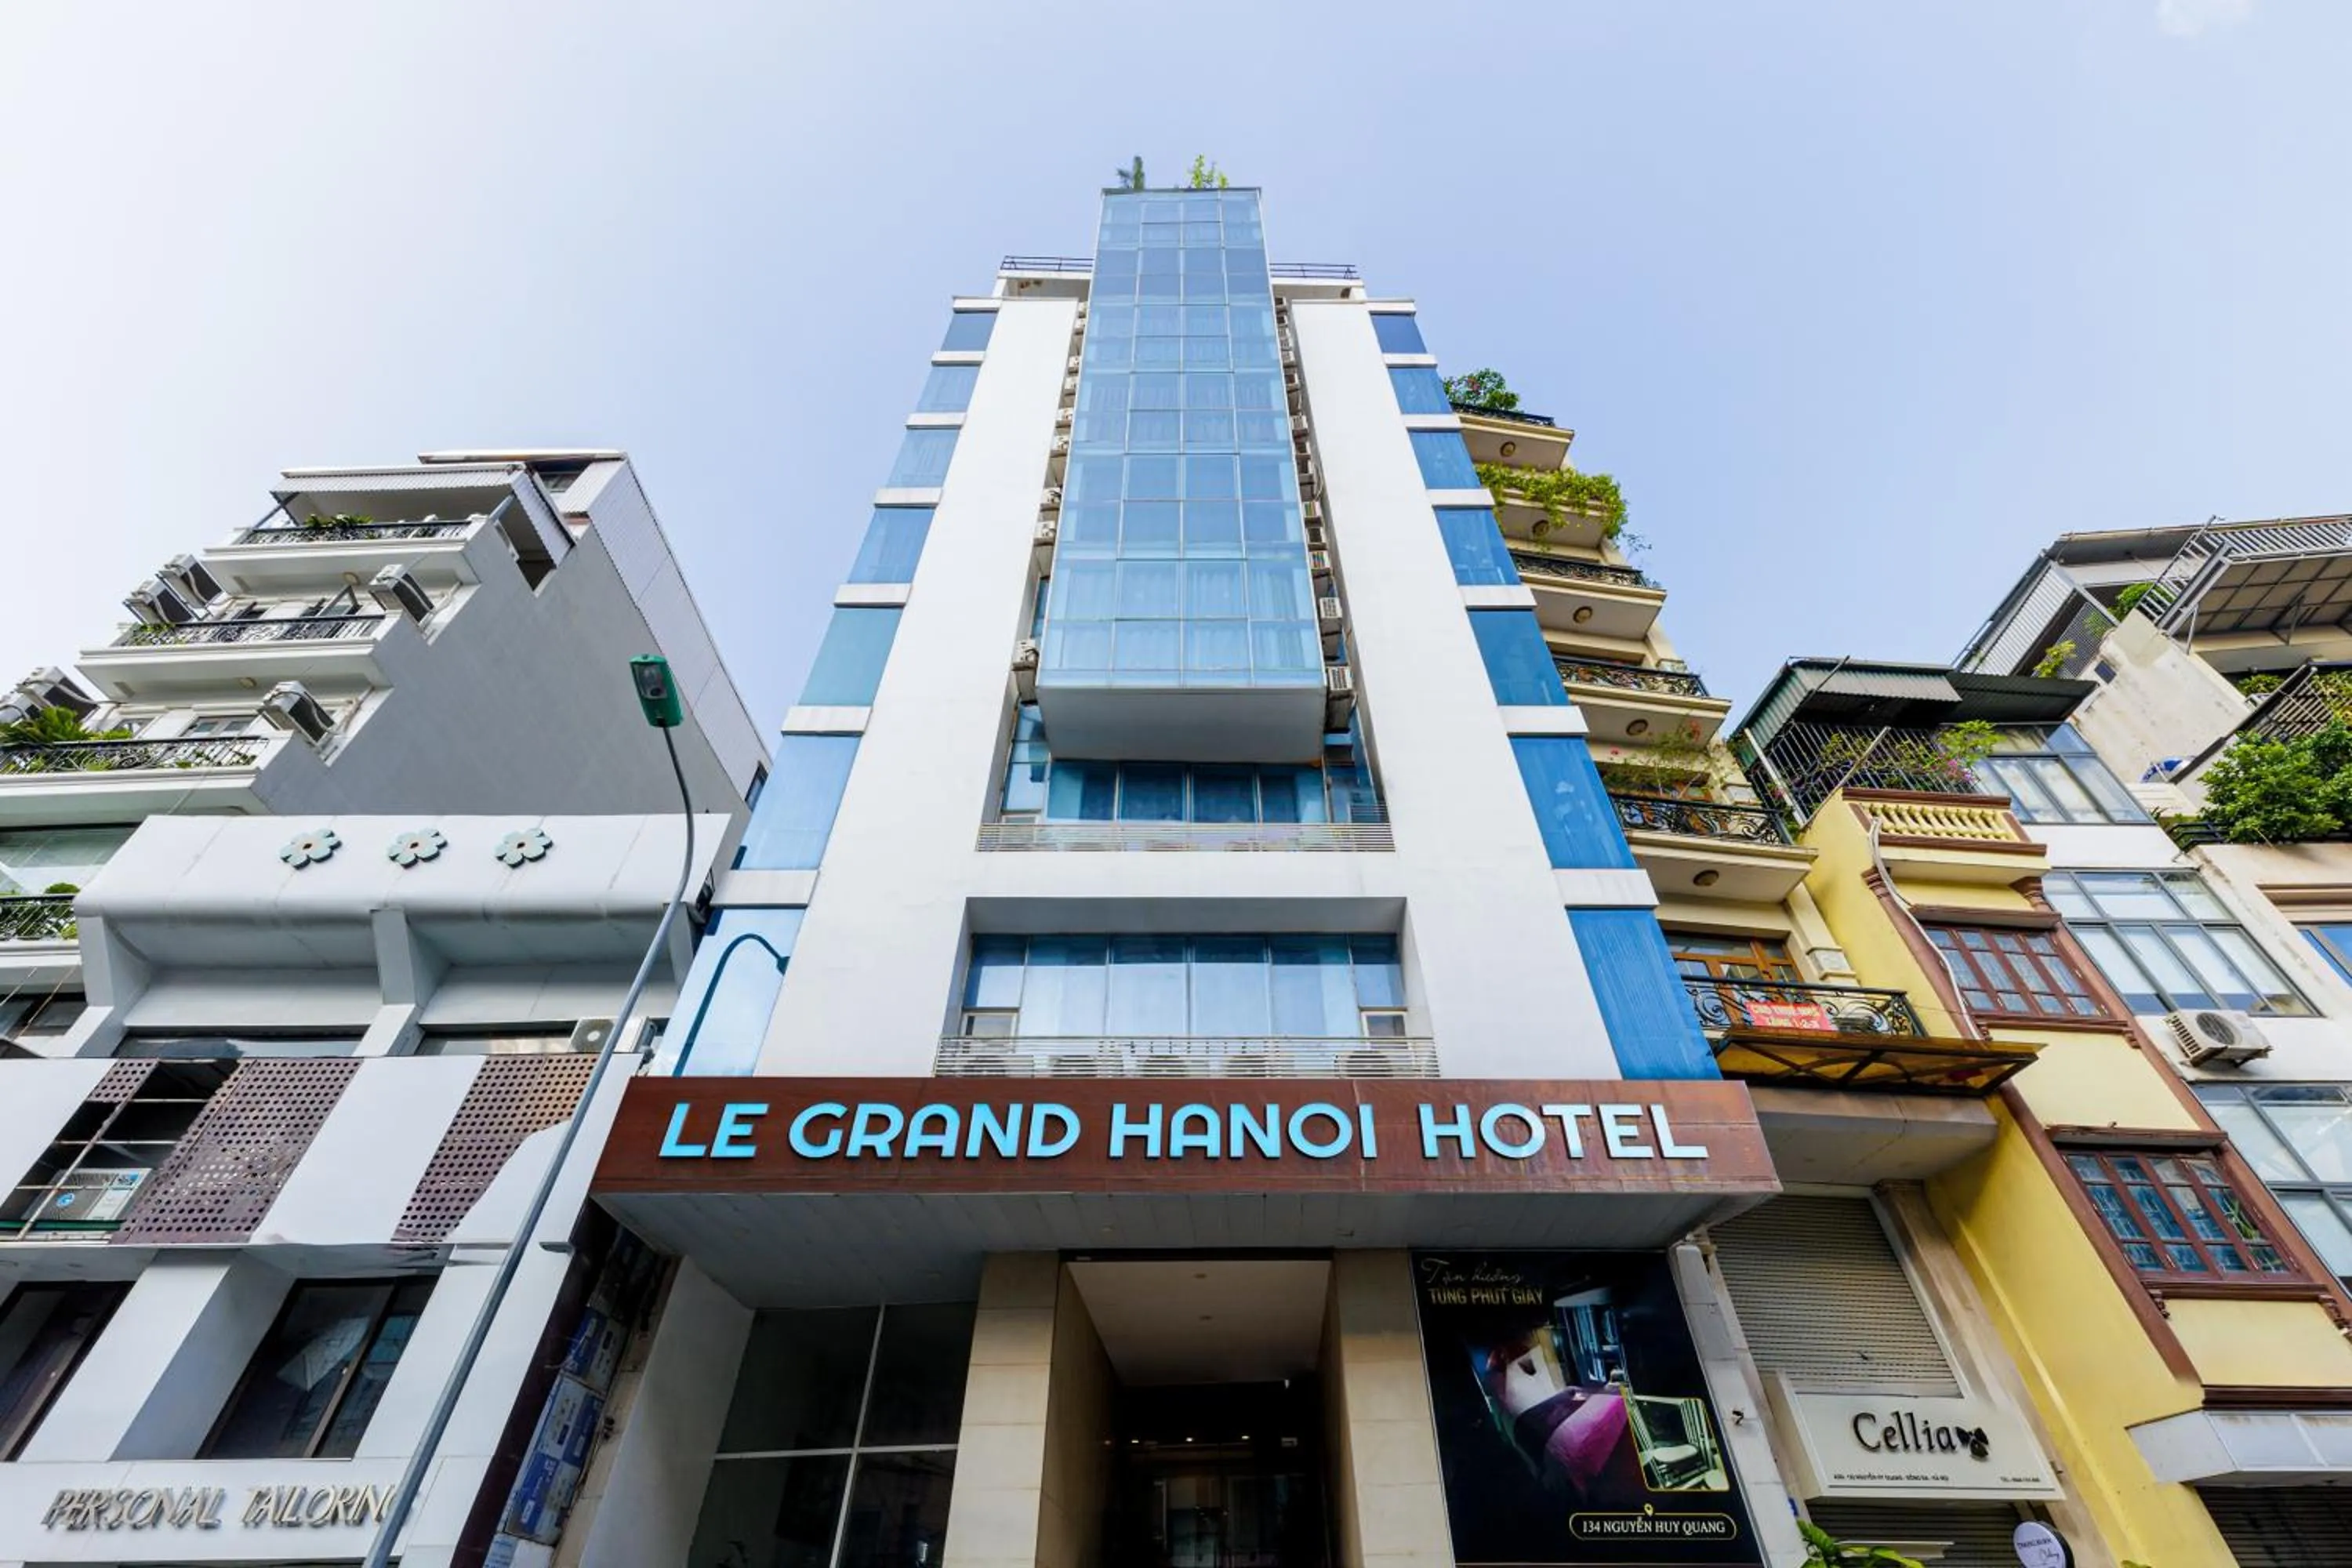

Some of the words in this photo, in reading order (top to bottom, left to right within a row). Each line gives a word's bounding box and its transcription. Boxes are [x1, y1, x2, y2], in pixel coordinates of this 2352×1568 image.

[659, 1102, 768, 1159] LE
[788, 1102, 1081, 1159] GRAND
[1108, 1102, 1377, 1159] HANOI
[1418, 1102, 1710, 1159] HOTEL
[1853, 1410, 1956, 1452] Cellia
[40, 1486, 226, 1530] PERSONAL
[1583, 1520, 1600, 1533] 134
[1655, 1520, 1680, 1533] HUY
[1682, 1520, 1726, 1535] QUANG
